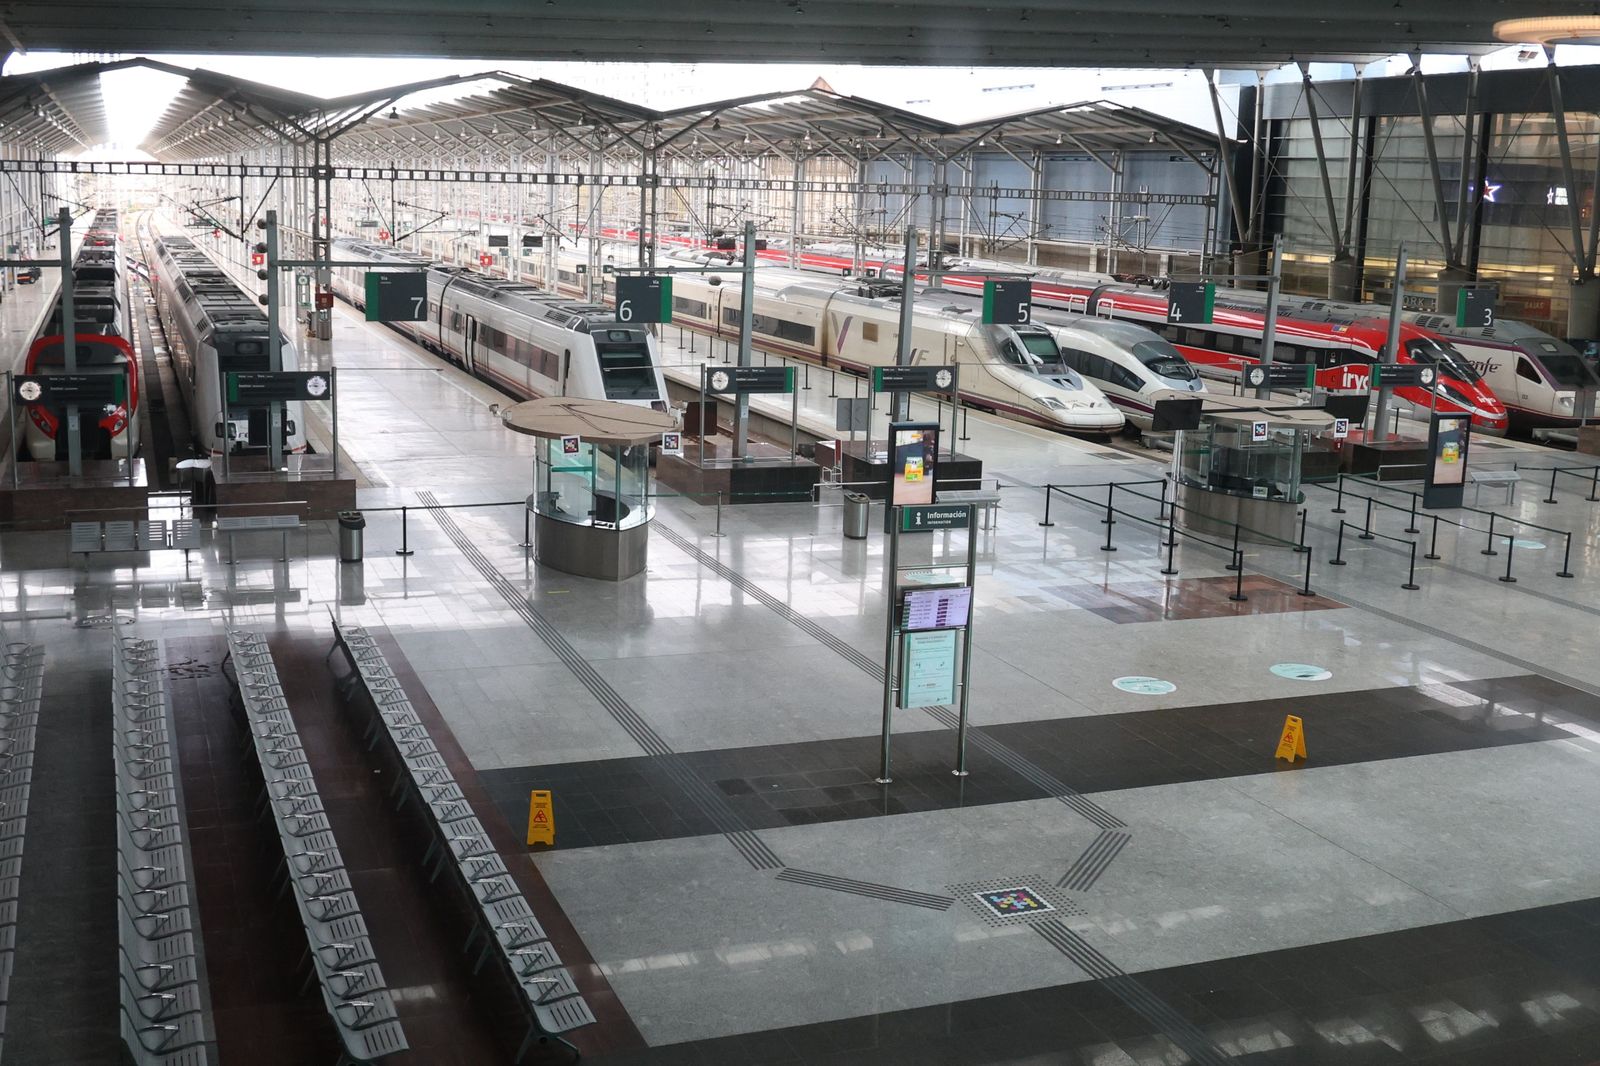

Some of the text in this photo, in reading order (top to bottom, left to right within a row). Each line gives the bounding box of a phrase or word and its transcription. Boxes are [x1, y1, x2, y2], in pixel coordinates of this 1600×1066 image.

[411, 297, 424, 319] 7
[619, 300, 633, 321] 6
[1403, 295, 1425, 307] ORK
[1018, 302, 1028, 323] 5
[1170, 302, 1182, 321] 4
[1483, 308, 1492, 326] 3
[1467, 357, 1502, 378] enfe
[927, 510, 967, 519] Información
